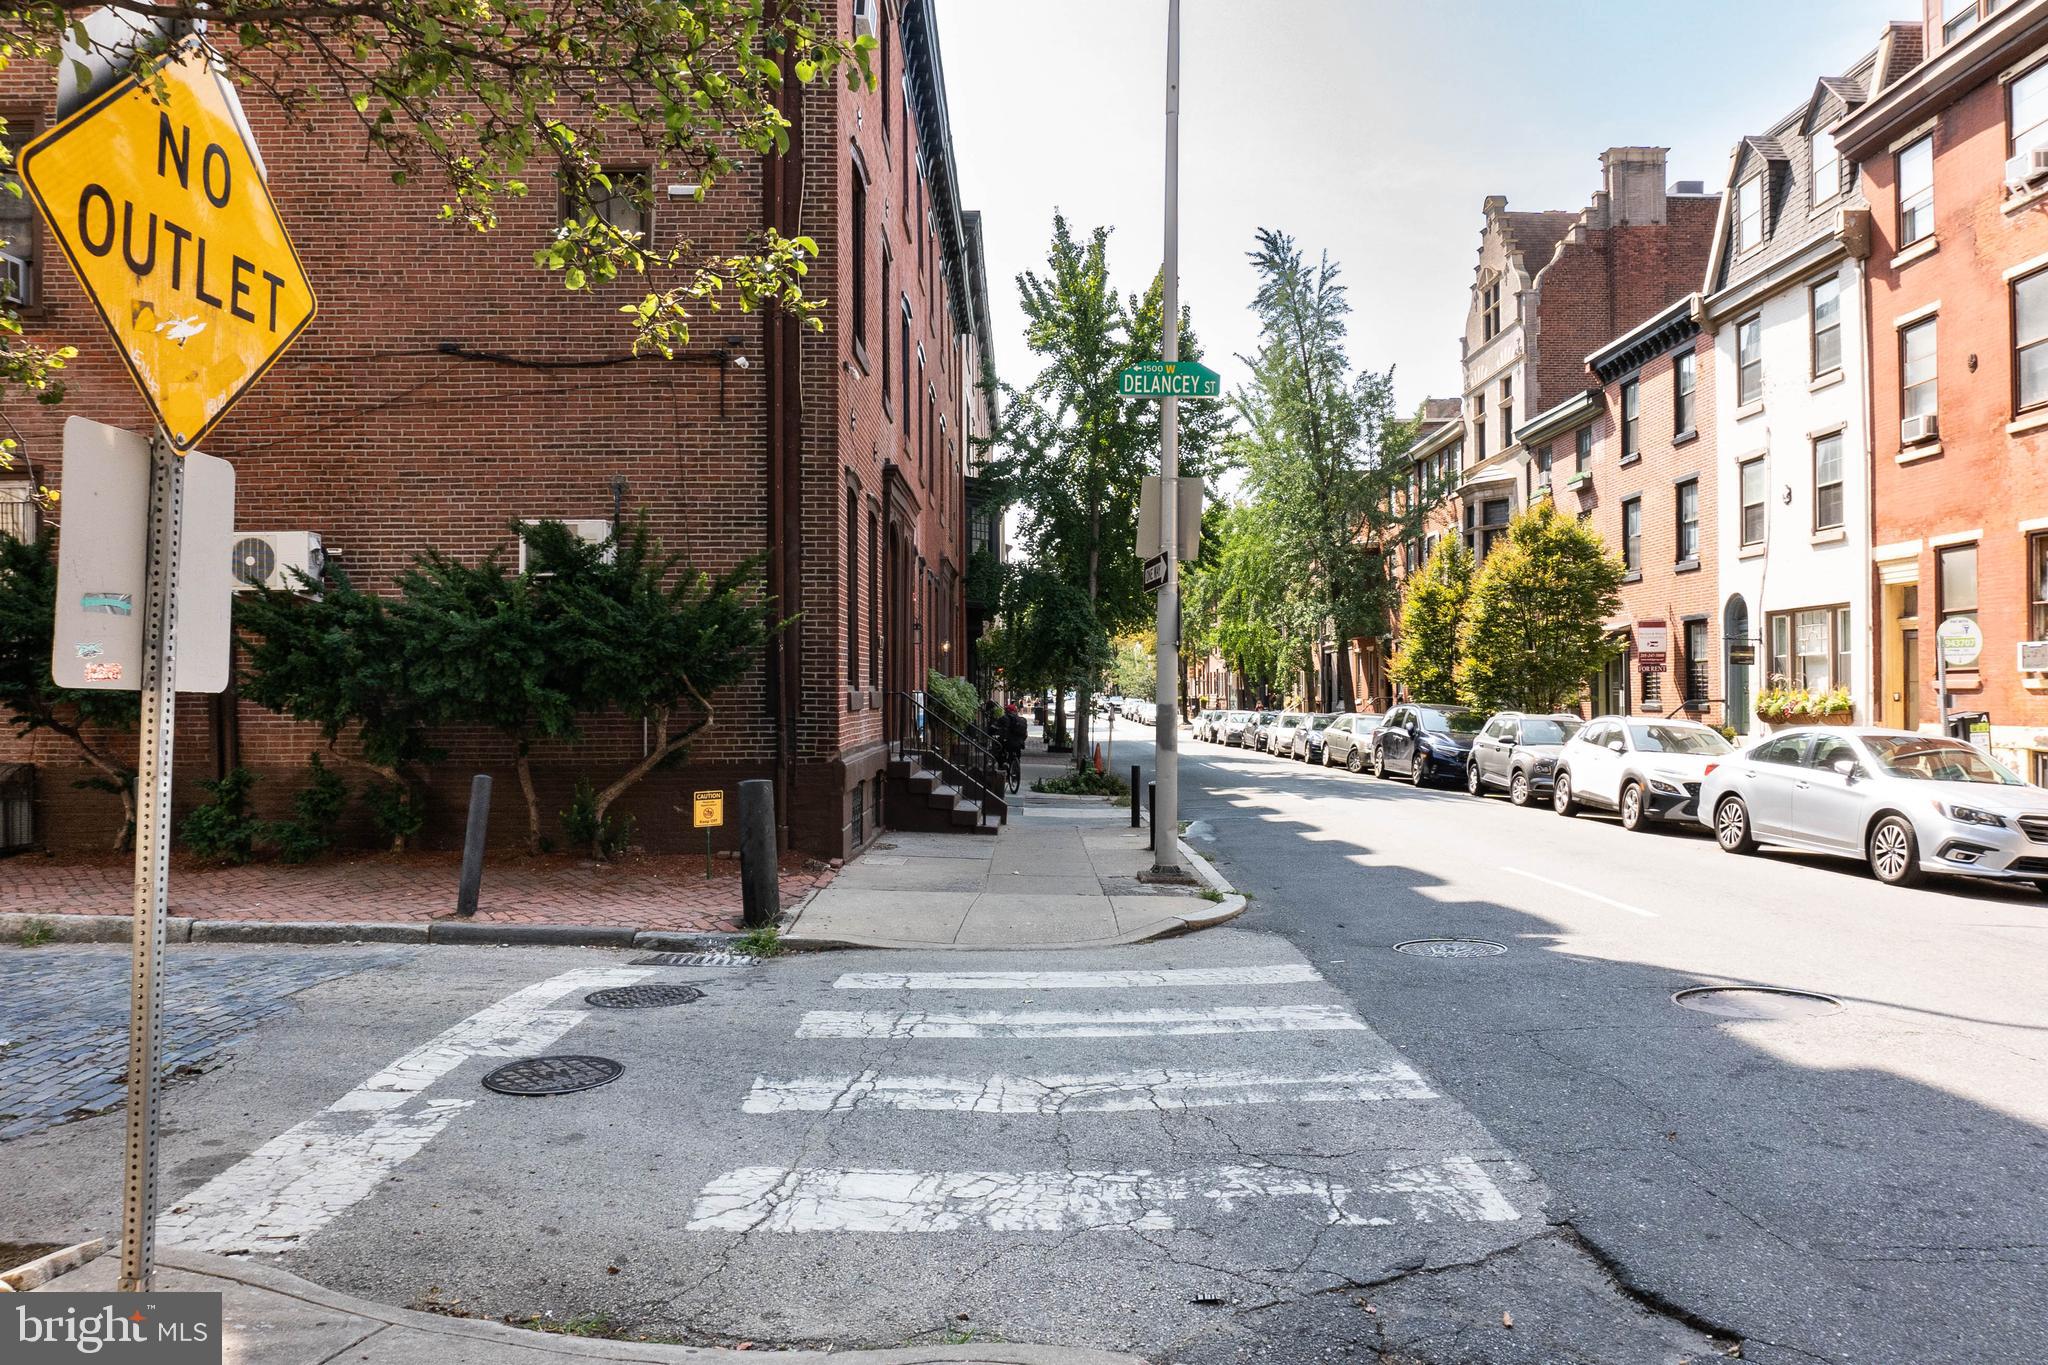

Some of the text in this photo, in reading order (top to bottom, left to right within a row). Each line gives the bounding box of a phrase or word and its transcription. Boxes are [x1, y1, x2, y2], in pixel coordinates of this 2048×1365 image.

[157, 111, 232, 209] NO
[78, 183, 285, 333] OUTLET
[1123, 374, 1216, 394] DELANCEY ST
[1143, 365, 1176, 374] 1500 W
